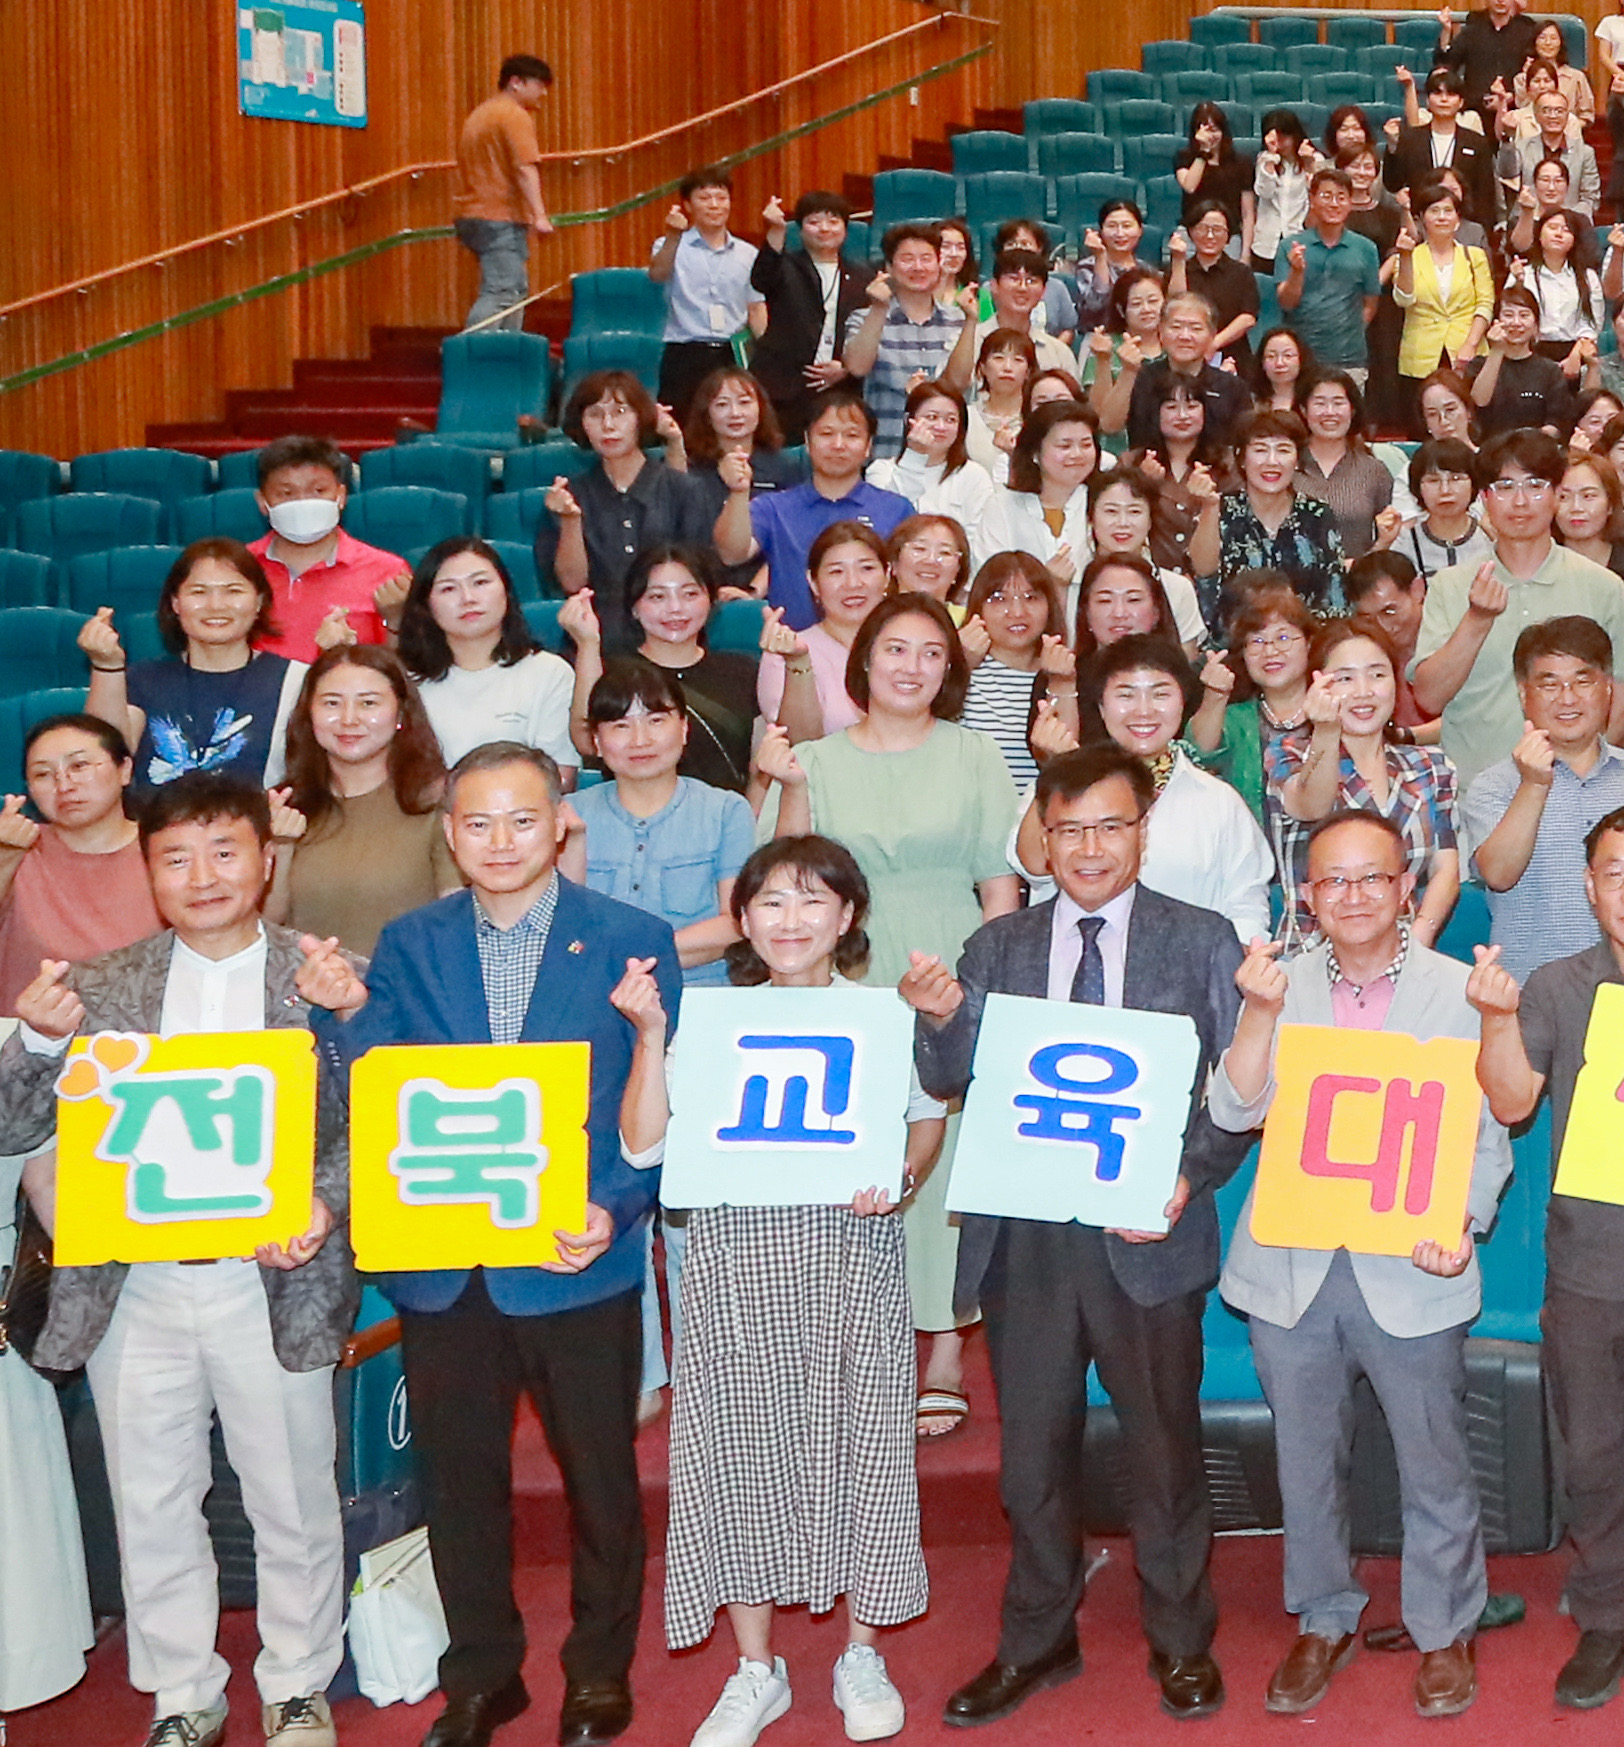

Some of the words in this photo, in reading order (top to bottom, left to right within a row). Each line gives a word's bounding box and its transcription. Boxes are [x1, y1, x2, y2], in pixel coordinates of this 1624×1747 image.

[109, 1075, 263, 1213] 전
[397, 1089, 538, 1220] 북
[717, 1035, 855, 1144] 교
[1013, 1043, 1141, 1181] 육
[1300, 1074, 1444, 1215] 대
